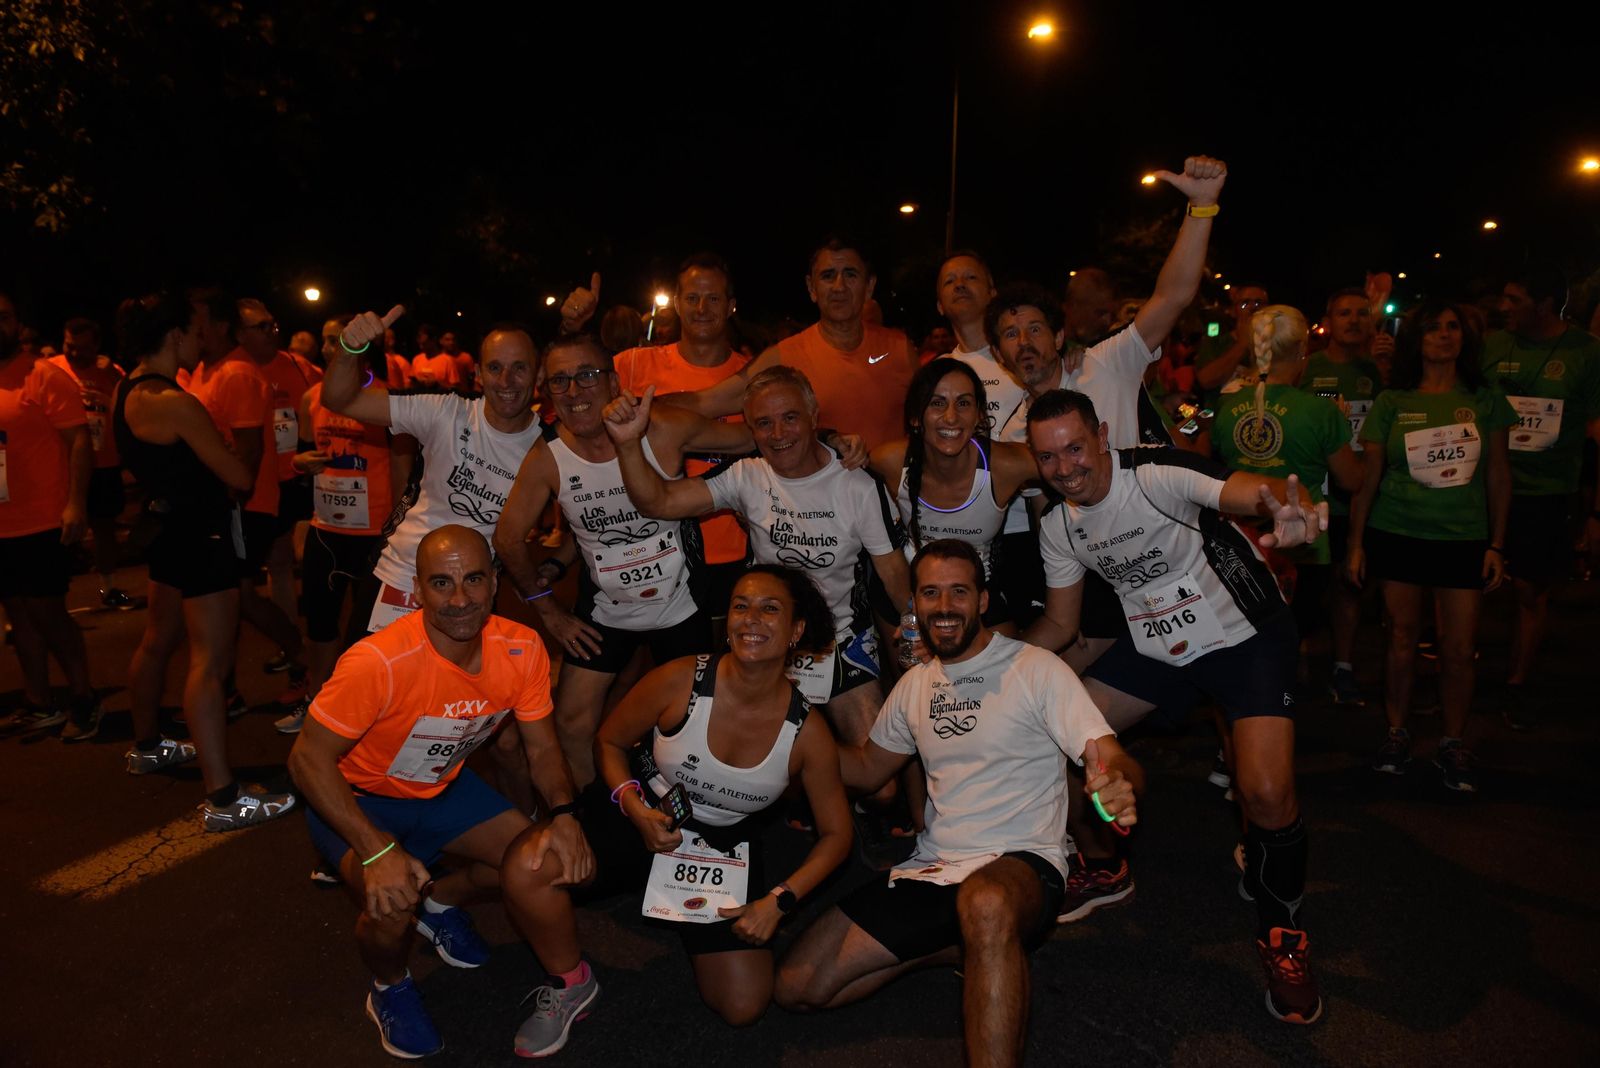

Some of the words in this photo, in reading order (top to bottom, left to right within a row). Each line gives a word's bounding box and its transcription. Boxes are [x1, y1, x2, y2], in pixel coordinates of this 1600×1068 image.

[1231, 400, 1289, 417] POLILAS
[274, 424, 289, 433] 55
[1518, 416, 1543, 429] 417
[1427, 446, 1466, 463] 5425
[458, 462, 475, 480] Los
[460, 447, 475, 462] CLUB
[475, 457, 486, 467] DE
[486, 463, 517, 481] ATLETISM
[447, 465, 507, 508] Legendario
[322, 493, 357, 507] 17592
[573, 493, 593, 503] CLUB
[594, 490, 606, 499] DE
[579, 508, 639, 533] Legendar
[583, 506, 606, 520] Los
[771, 504, 787, 516] CLUB
[797, 510, 835, 519] ATLETISMO
[775, 518, 794, 533] Los
[942, 527, 983, 535] ATLETISMO
[770, 523, 838, 549] Legendarios
[1087, 543, 1101, 552] CLUB
[1100, 540, 1109, 549] DE
[1109, 527, 1145, 547] ATLETISMO
[1096, 555, 1116, 567] Los
[1097, 546, 1163, 580] Legendarios
[620, 562, 663, 585] 9321
[1143, 609, 1197, 638] 20016
[933, 692, 946, 704] Los
[442, 699, 489, 718] XXXV
[929, 697, 981, 720] Legendarios
[675, 771, 699, 786] CLUB
[702, 782, 716, 791] DE
[718, 787, 769, 803] ATLETISMO
[674, 863, 724, 885] 8878
